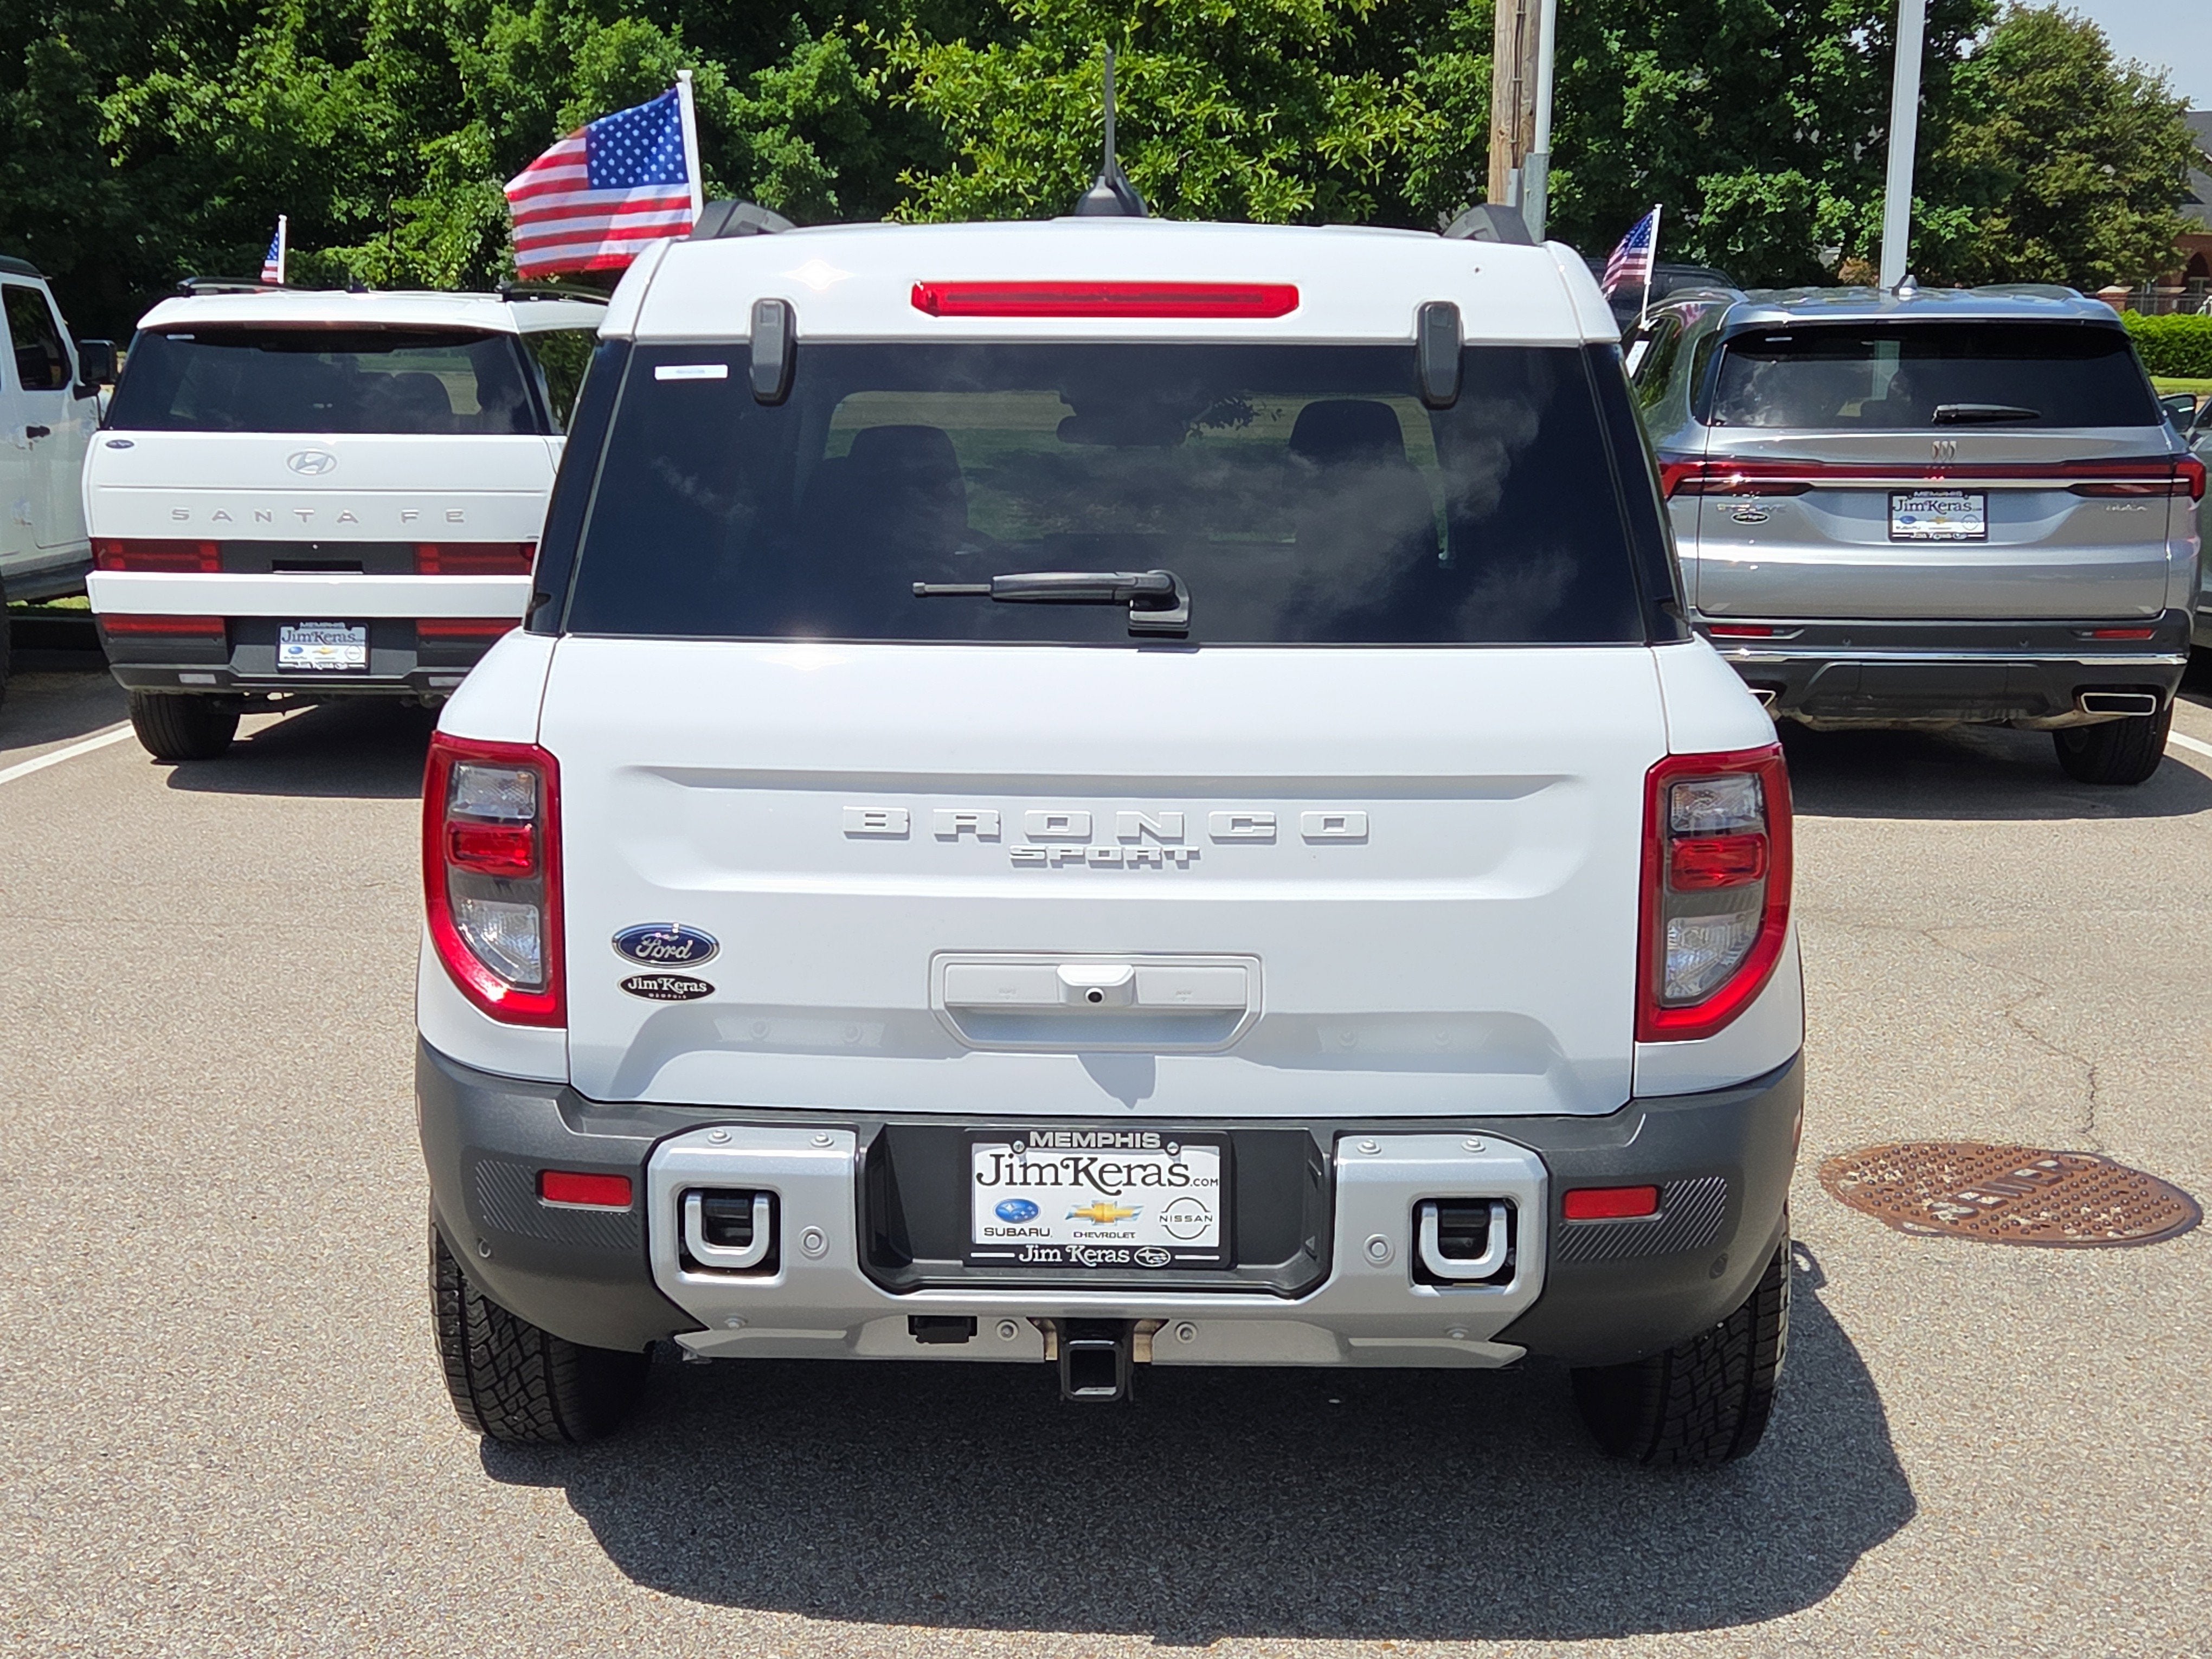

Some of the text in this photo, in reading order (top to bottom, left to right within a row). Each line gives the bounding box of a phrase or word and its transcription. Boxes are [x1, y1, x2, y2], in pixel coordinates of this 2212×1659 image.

[171, 509, 465, 524] SANTA FE
[843, 806, 1369, 841] BRONCO
[1009, 845, 1200, 866] SPORT
[635, 932, 693, 959] Ford
[1030, 1131, 1161, 1149] MEMPHIS
[1159, 1214, 1213, 1223] NISSAN
[983, 1227, 1051, 1237] SUBARU
[1019, 1245, 1130, 1268] Jim Keras
